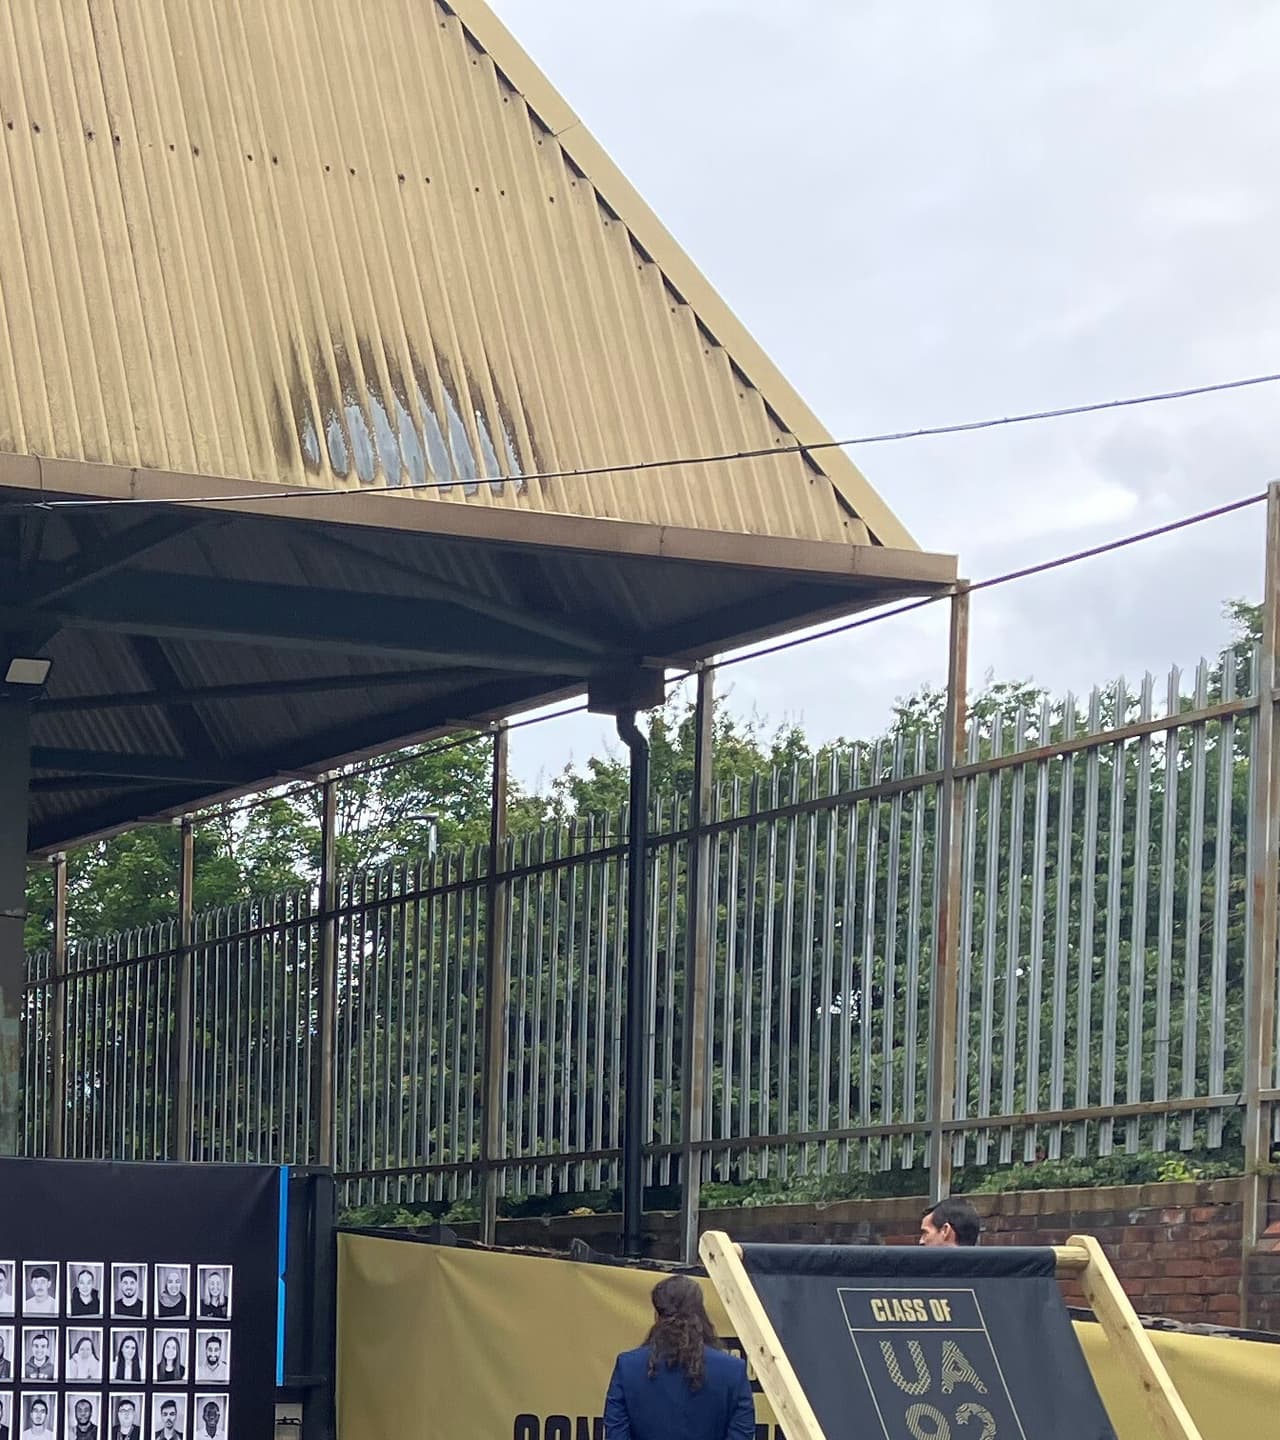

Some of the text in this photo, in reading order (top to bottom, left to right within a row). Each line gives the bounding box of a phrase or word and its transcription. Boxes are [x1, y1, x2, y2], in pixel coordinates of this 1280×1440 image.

[870, 1298, 953, 1322] CLASS OF
[879, 1340, 988, 1395] UA
